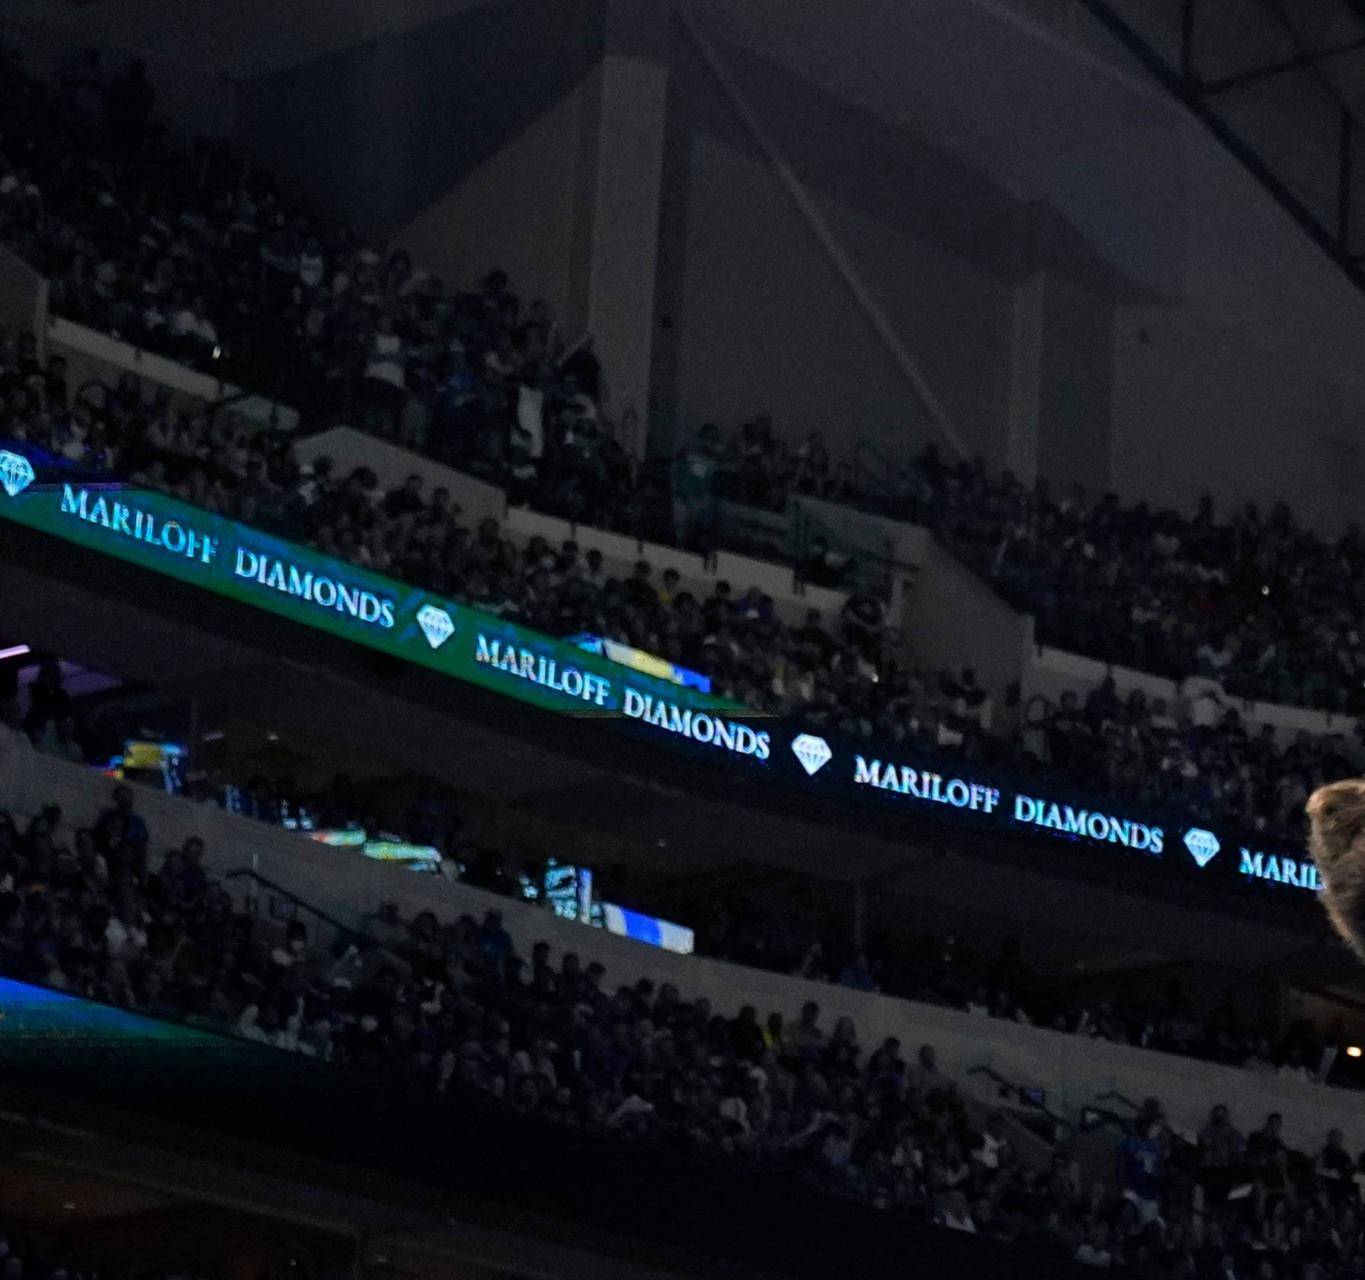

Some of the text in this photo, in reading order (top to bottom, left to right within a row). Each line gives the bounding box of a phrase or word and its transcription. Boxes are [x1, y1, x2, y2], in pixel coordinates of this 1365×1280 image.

[60, 484, 395, 630] MARILOFF DIAMONDS
[474, 633, 771, 761] MARILOFF DIAMONDS
[854, 755, 1165, 855] MARILOFF DIAMONDS
